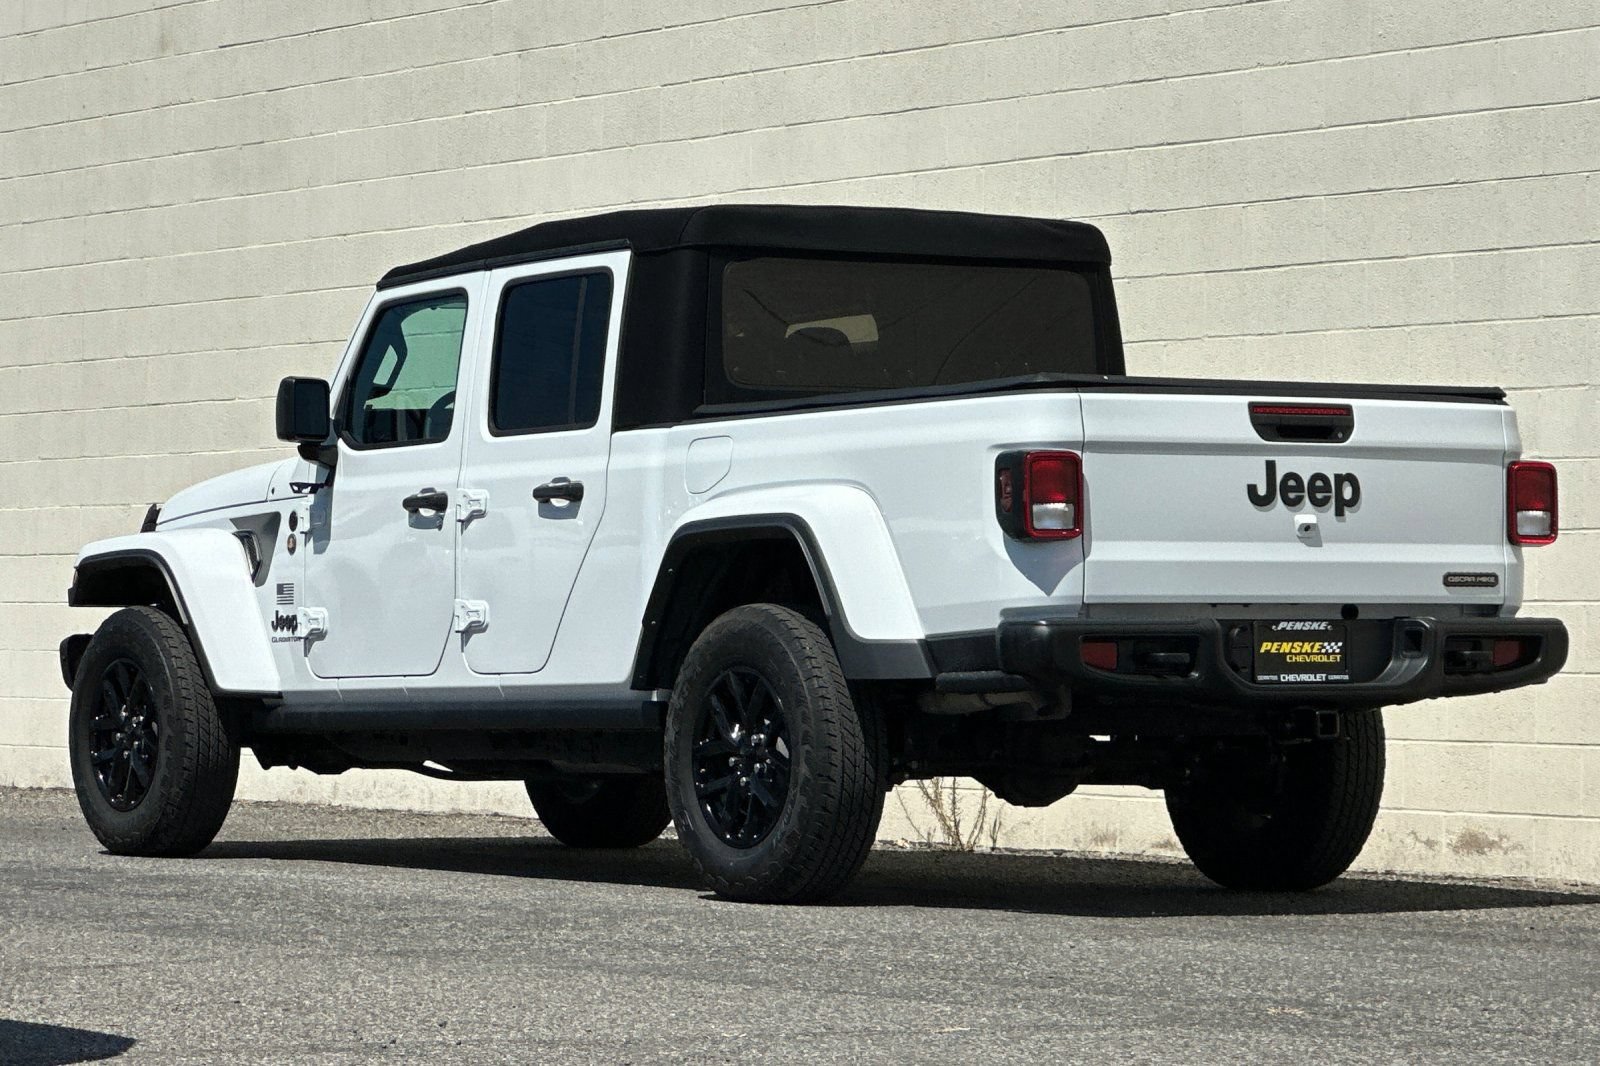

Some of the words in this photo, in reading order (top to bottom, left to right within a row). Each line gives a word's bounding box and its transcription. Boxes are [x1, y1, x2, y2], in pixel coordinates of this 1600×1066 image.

[1247, 460, 1360, 517] Jeep
[271, 610, 298, 635] Jeep
[1278, 621, 1329, 631] PENSKE
[1260, 642, 1324, 653] PENSKE
[1280, 673, 1327, 682] CHEVROLET
